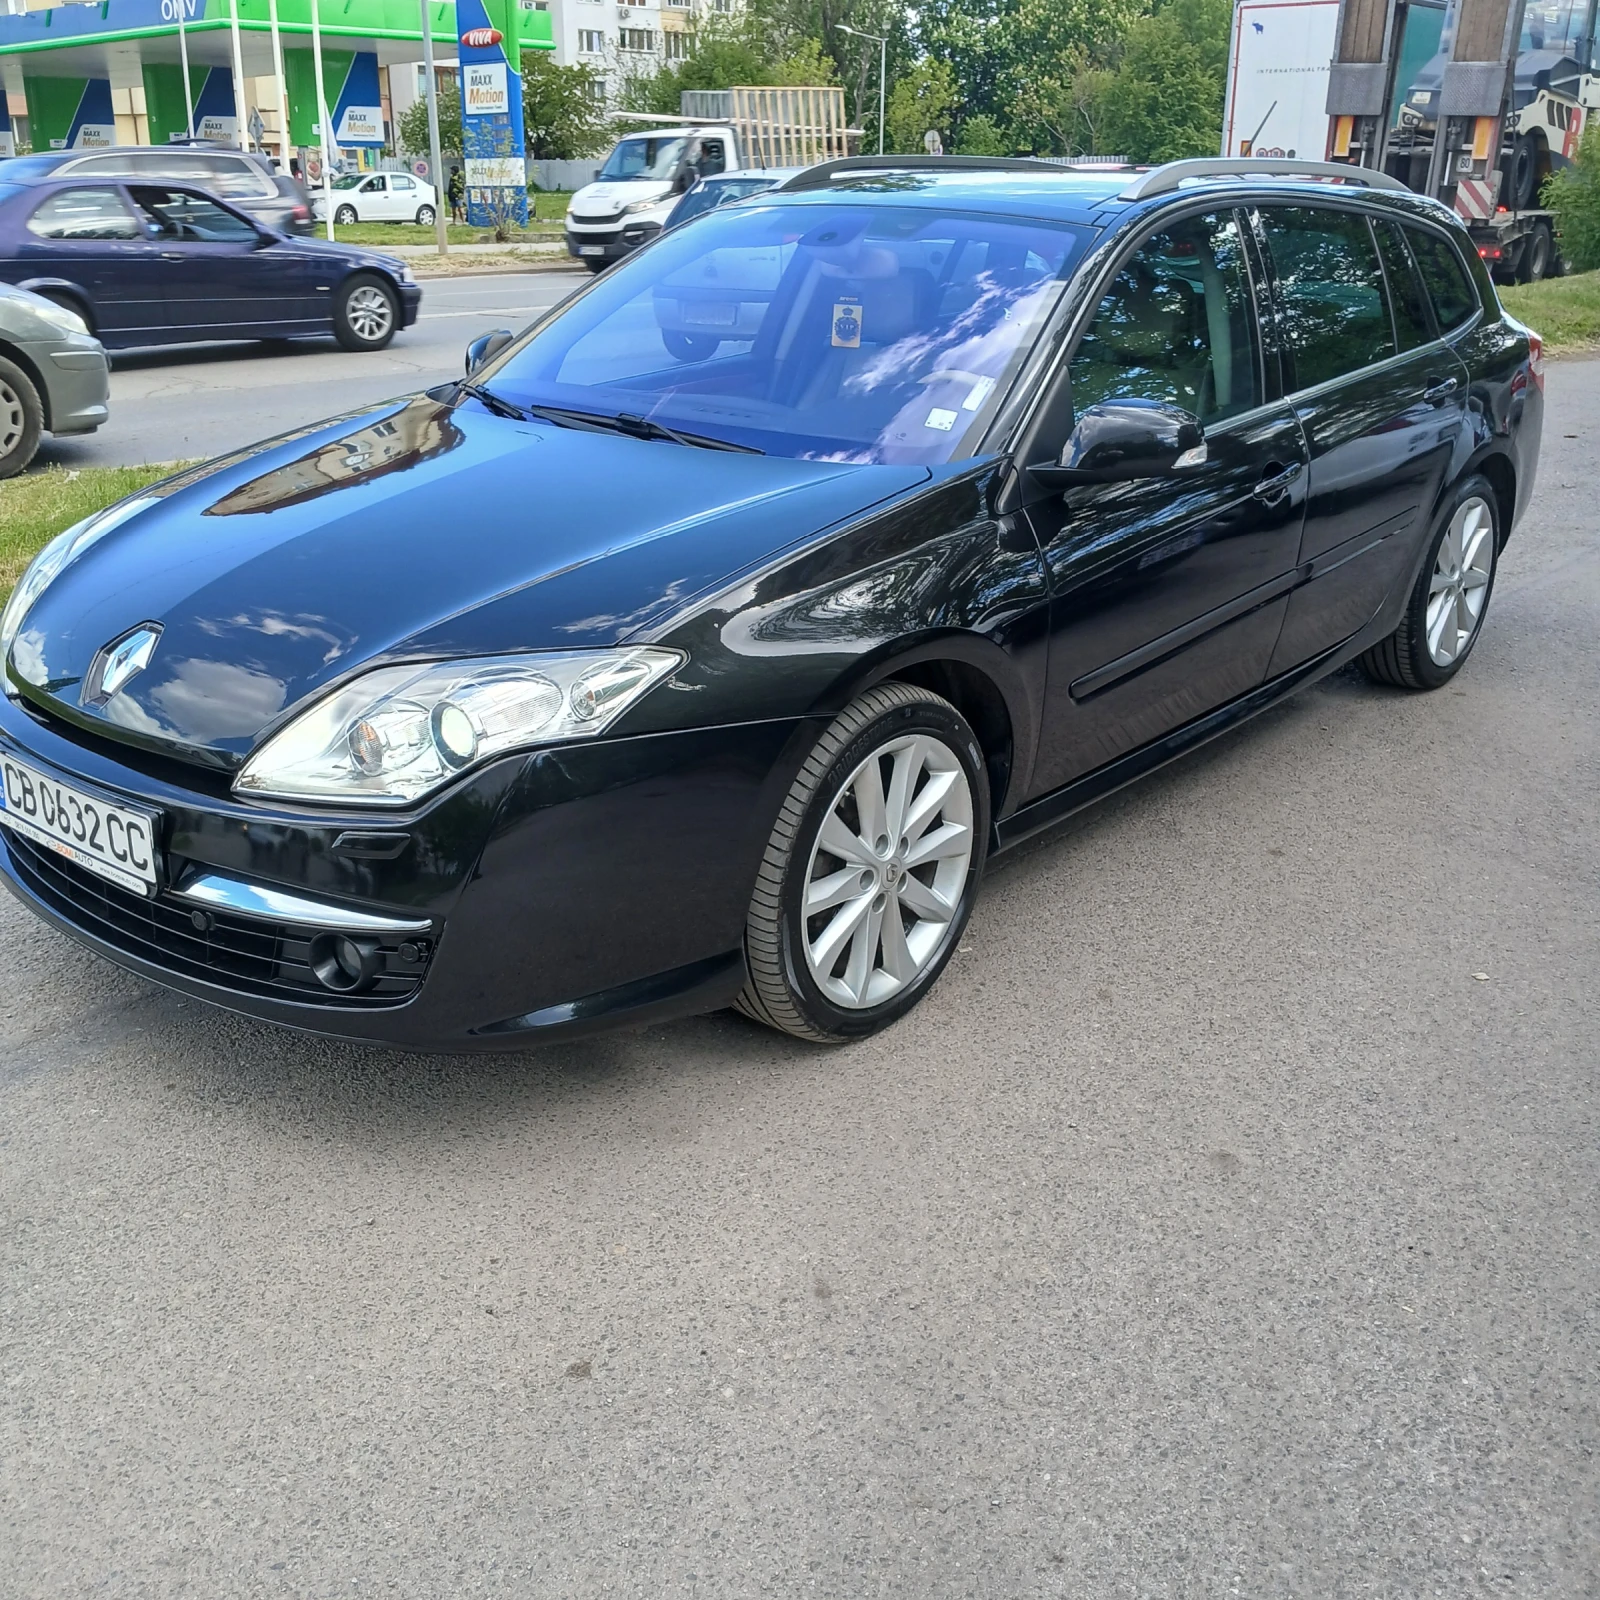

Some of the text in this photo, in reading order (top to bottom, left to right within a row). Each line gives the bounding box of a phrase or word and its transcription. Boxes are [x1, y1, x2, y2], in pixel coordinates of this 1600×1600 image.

[161, 0, 196, 20] OMV
[468, 30, 493, 46] VIVA
[470, 74, 493, 86] MAXX
[468, 87, 504, 104] Motion
[348, 113, 367, 121] MAXX
[347, 122, 376, 133] Motion
[203, 129, 232, 140] Motion
[82, 137, 110, 146] Motion
[1460, 157, 1471, 168] 80
[827, 716, 893, 787] BRIDGESTONE
